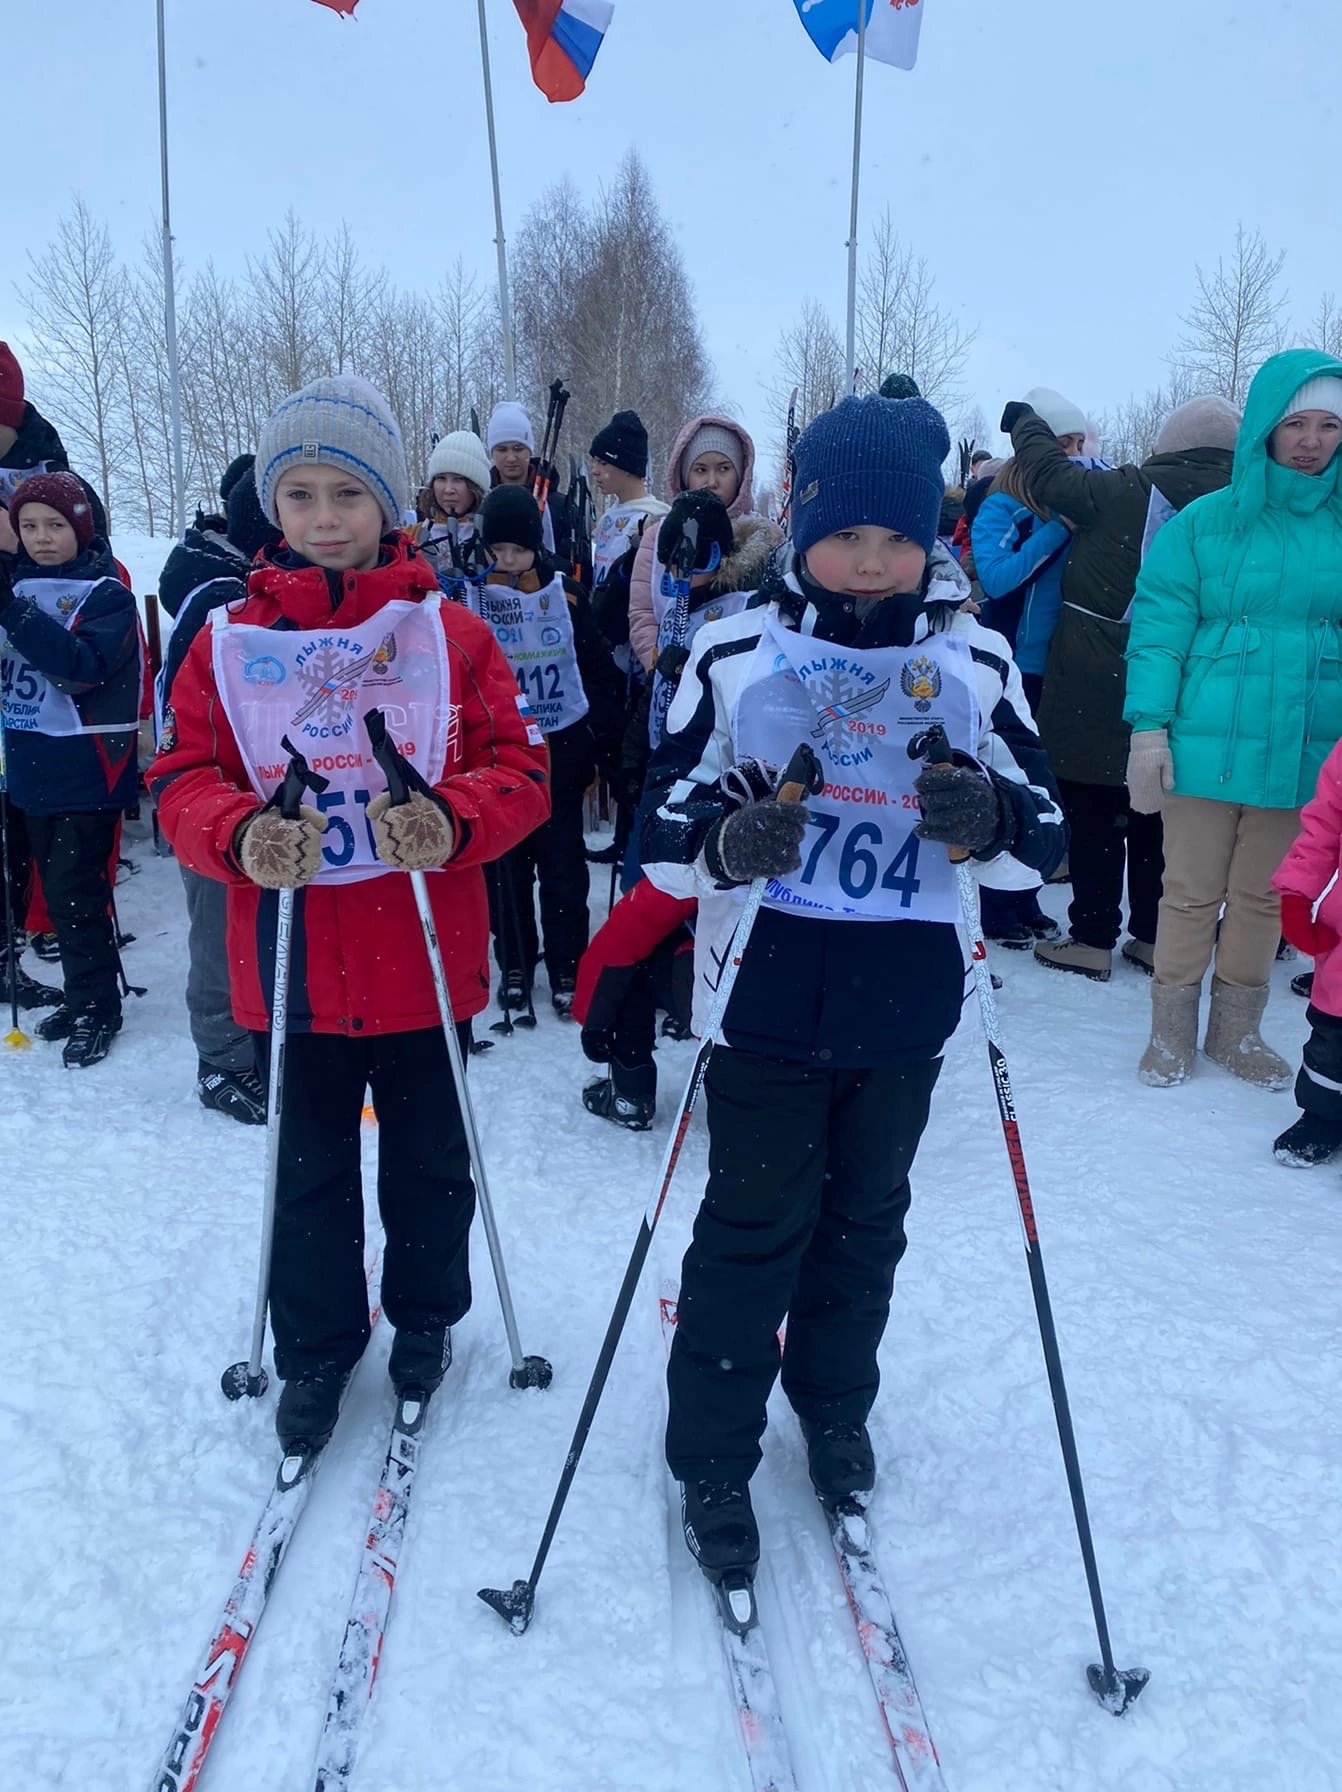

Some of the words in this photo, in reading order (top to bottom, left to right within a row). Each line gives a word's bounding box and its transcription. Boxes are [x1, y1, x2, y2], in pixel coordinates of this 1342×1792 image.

[296, 637, 363, 668] ЛЫЖНЯ
[799, 657, 876, 685] ЛЫЖНЯ
[848, 720, 887, 736] 2019
[821, 783, 888, 806] РОССИИ
[799, 811, 921, 908] 764
[205, 1074, 225, 1091] TREK
